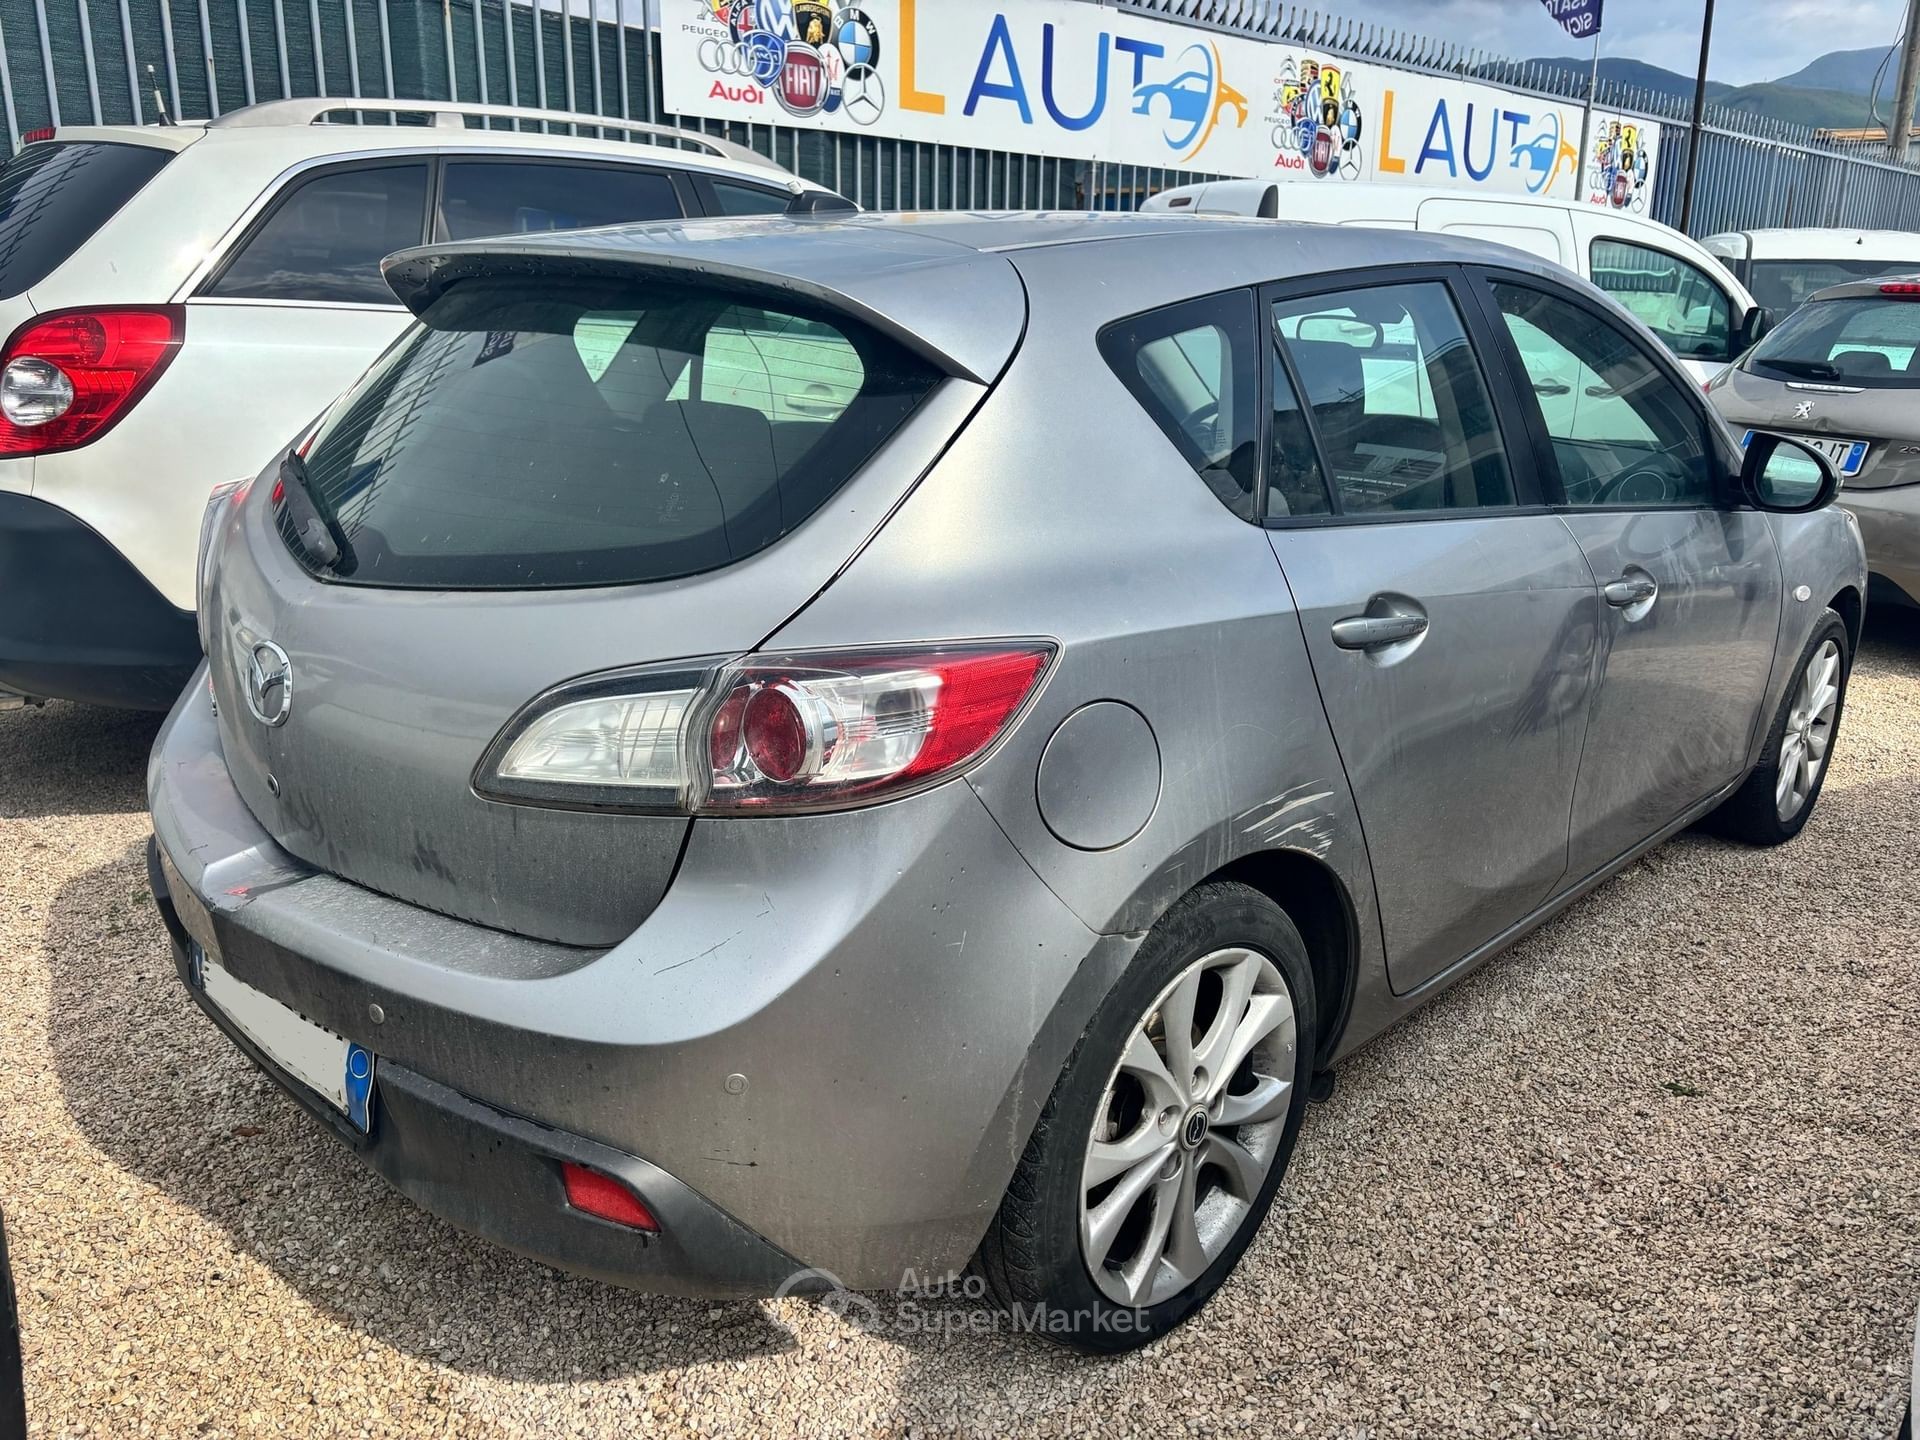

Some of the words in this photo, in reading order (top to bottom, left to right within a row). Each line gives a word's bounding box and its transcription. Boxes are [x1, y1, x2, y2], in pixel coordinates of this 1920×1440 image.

[833, 8, 876, 35] BMW
[785, 62, 818, 96] FIAT
[708, 80, 763, 104] Audi
[1274, 153, 1305, 169] Audi
